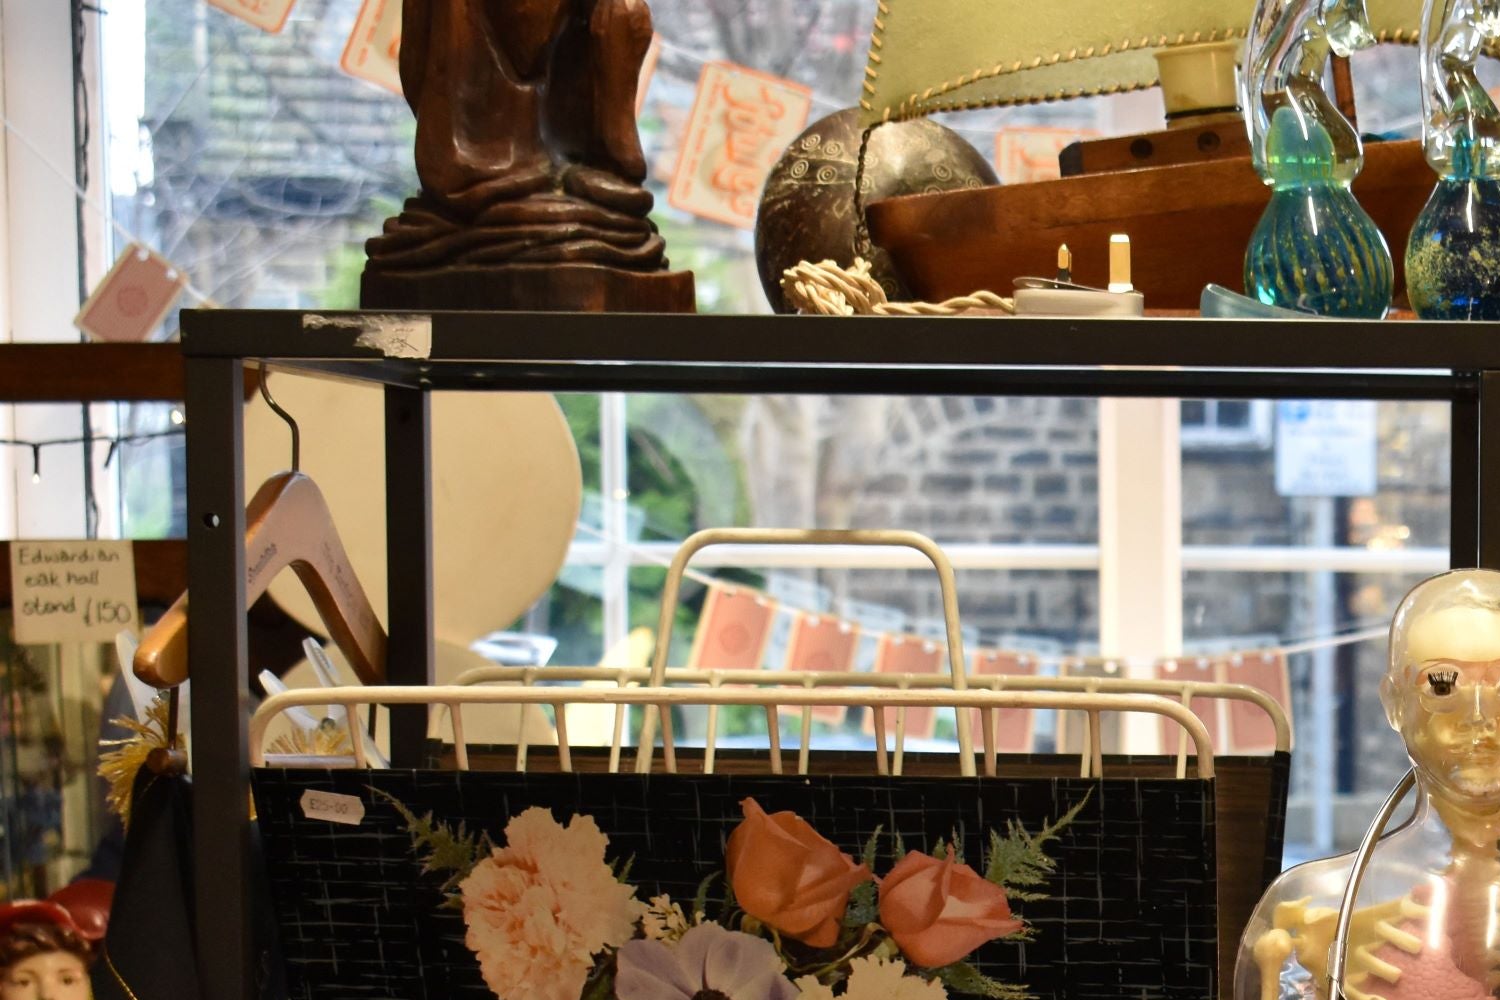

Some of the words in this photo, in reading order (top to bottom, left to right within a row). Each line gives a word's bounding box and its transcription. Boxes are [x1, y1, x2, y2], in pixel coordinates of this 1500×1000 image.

[18, 547, 120, 565] Edwardian
[66, 569, 99, 586] hall
[23, 596, 76, 615] stand
